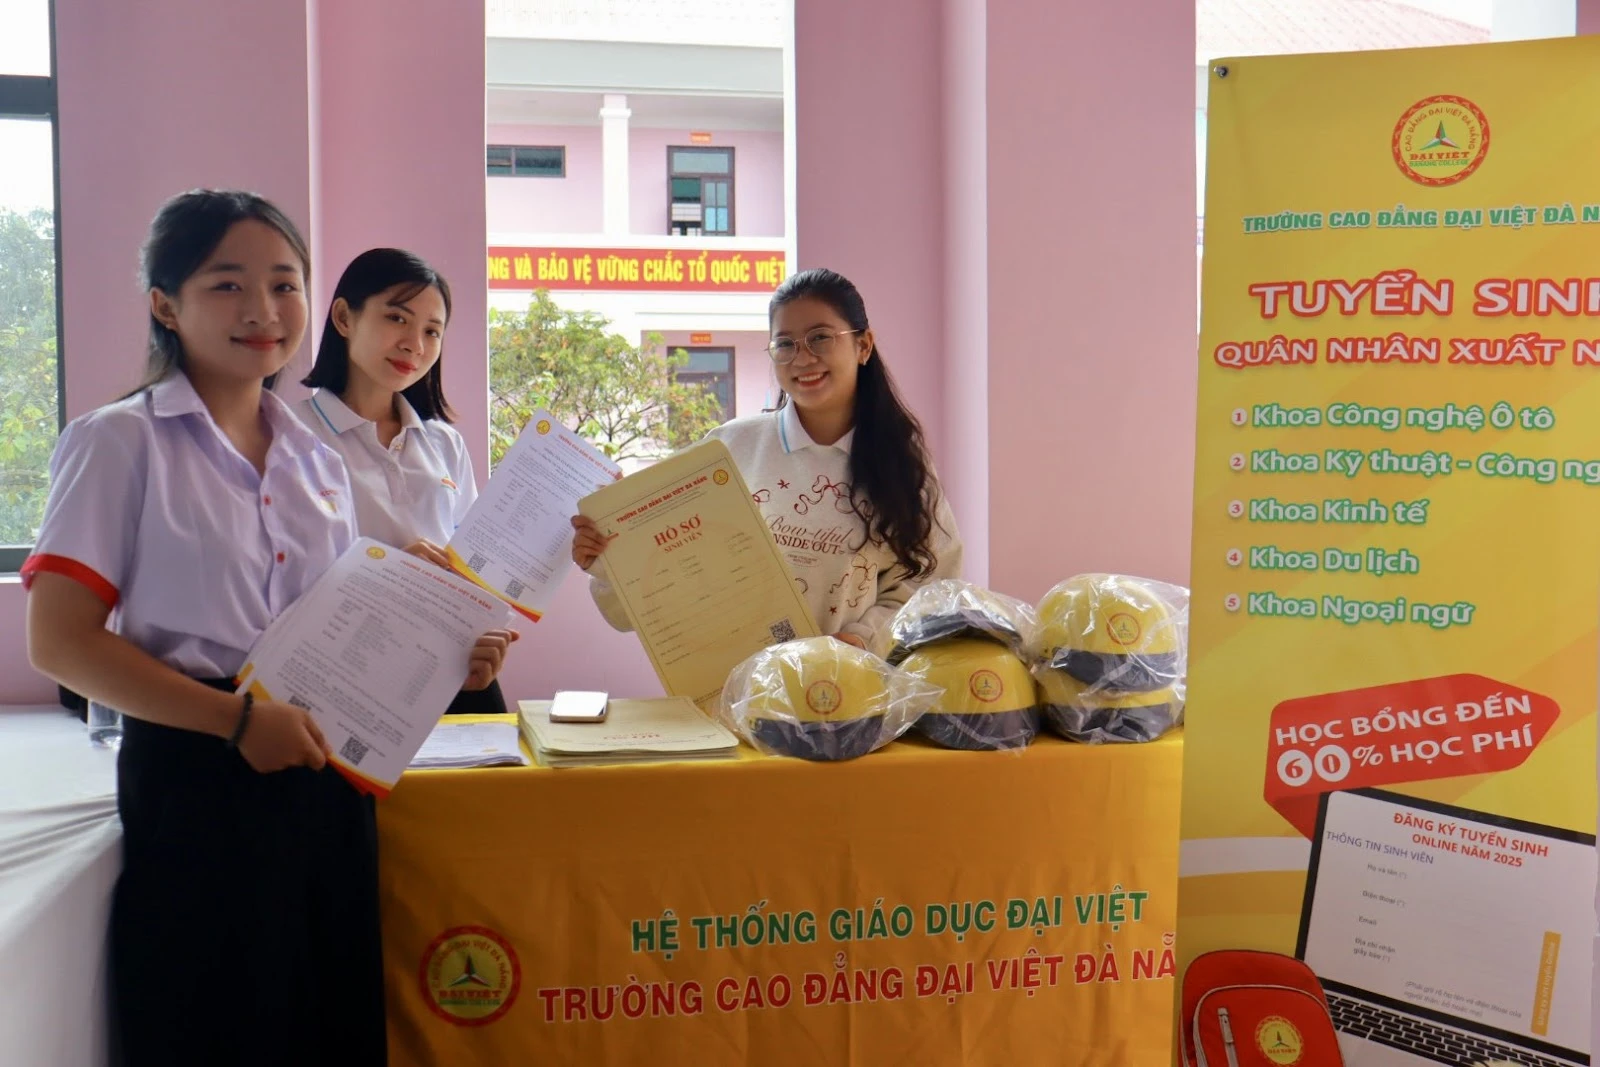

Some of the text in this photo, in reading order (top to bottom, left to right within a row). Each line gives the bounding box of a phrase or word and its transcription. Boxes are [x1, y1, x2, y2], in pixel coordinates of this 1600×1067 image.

[1244, 210, 1322, 232] TRƯỜNG
[1329, 211, 1370, 227] CAO
[1377, 204, 1438, 226] ĐẲNG
[1444, 210, 1481, 229] ĐẠI
[1489, 206, 1537, 228] VIỆT
[1544, 204, 1574, 223] ĐÀ
[514, 252, 533, 280] VÀ
[538, 251, 568, 280] BẢO
[573, 254, 592, 285] VỆ
[597, 255, 639, 282] VỮNG
[644, 251, 683, 282] CHẮC
[688, 250, 708, 282] TỔ
[711, 254, 750, 285] QUỐC
[755, 256, 785, 287] VIỆT
[1250, 272, 1451, 316] TUYỂN
[1216, 337, 1315, 366] QUÂN
[1328, 334, 1438, 362] NHÂN
[1451, 335, 1562, 363] XUẤT
[1253, 404, 1320, 426] Khoa
[1327, 404, 1400, 430] Công
[1407, 404, 1484, 431] nghệ
[1491, 402, 1513, 427] Ô
[1520, 407, 1554, 429] tô
[1252, 450, 1319, 471] Khoa
[1325, 451, 1363, 476] Kỹ
[1369, 450, 1451, 476] thuật
[1478, 454, 1556, 482] Công
[680, 514, 701, 534] SƠ
[1250, 500, 1317, 522] Khoa
[1324, 500, 1387, 522] Kinh
[1394, 500, 1428, 523] tế
[812, 540, 841, 555] OUT
[1250, 547, 1318, 569] Khoa
[1324, 550, 1361, 570] Du
[1368, 549, 1418, 575] lịch
[1249, 594, 1317, 616] Khoa
[1323, 596, 1405, 624] Ngoại
[1412, 602, 1473, 628] ngữ
[1275, 692, 1532, 747] HỌC BỔNG ĐẾN
[1390, 736, 1464, 764] HỌC
[1472, 723, 1533, 753] PHÍ
[1326, 830, 1434, 864] THÔNG TIN SINH VIÊN
[1393, 812, 1549, 857] ĐĂNG KÝ TUYỂN SINH
[1412, 833, 1523, 867] ONLINE NĂM 2025
[632, 884, 1148, 960] HỆ THỐNG GIÁO DỤC ĐẠI VIỆT
[538, 974, 703, 1023] TRƯỜNG
[715, 974, 792, 1013] CAO
[803, 951, 905, 1005] ĐẲNG
[916, 962, 974, 1004] ĐẠI
[986, 948, 1064, 997] VIỆT
[1074, 943, 1120, 984] ĐÀ
